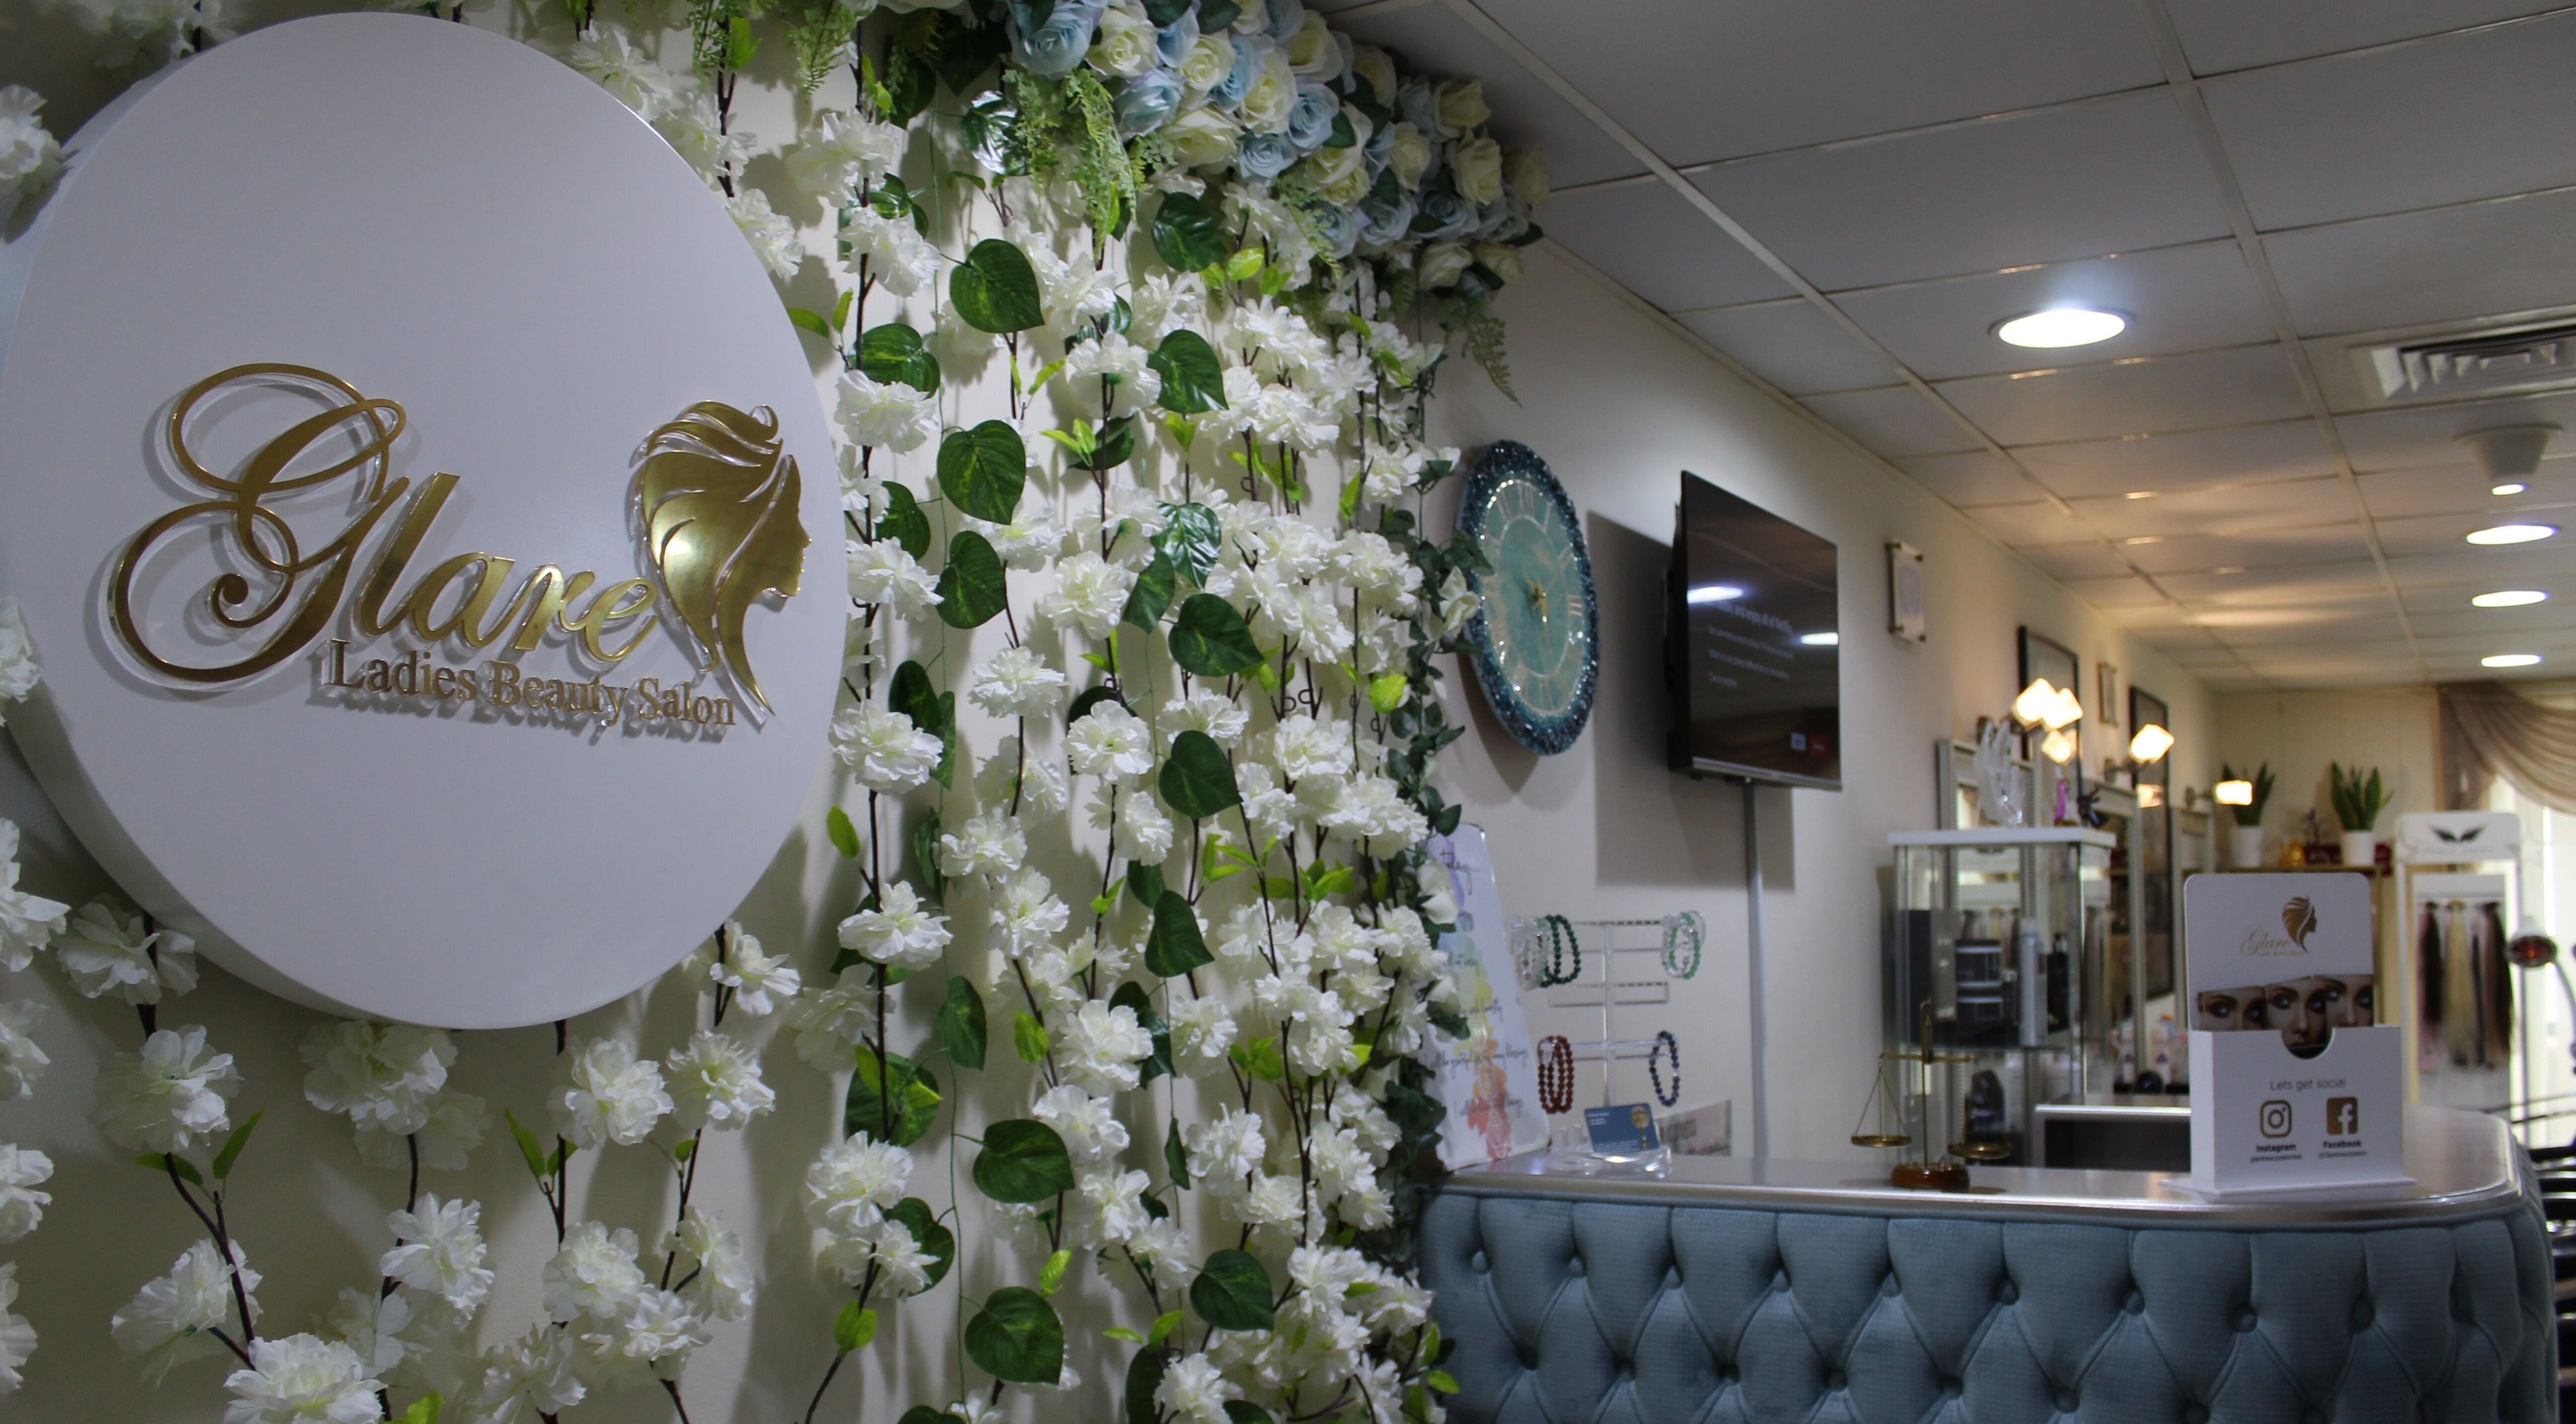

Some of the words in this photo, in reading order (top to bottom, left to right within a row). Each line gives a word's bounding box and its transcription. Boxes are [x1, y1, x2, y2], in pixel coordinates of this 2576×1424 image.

[111, 362, 659, 683] Glare
[329, 638, 477, 702] Ladies
[489, 659, 629, 726] Beauty
[638, 676, 737, 726] Salon
[2269, 1080, 2293, 1091] Lets
[2296, 1079, 2314, 1092] get
[2316, 1077, 2347, 1089] social
[2256, 1143, 2297, 1154] Instagram
[2322, 1139, 2363, 1149] Facebook
